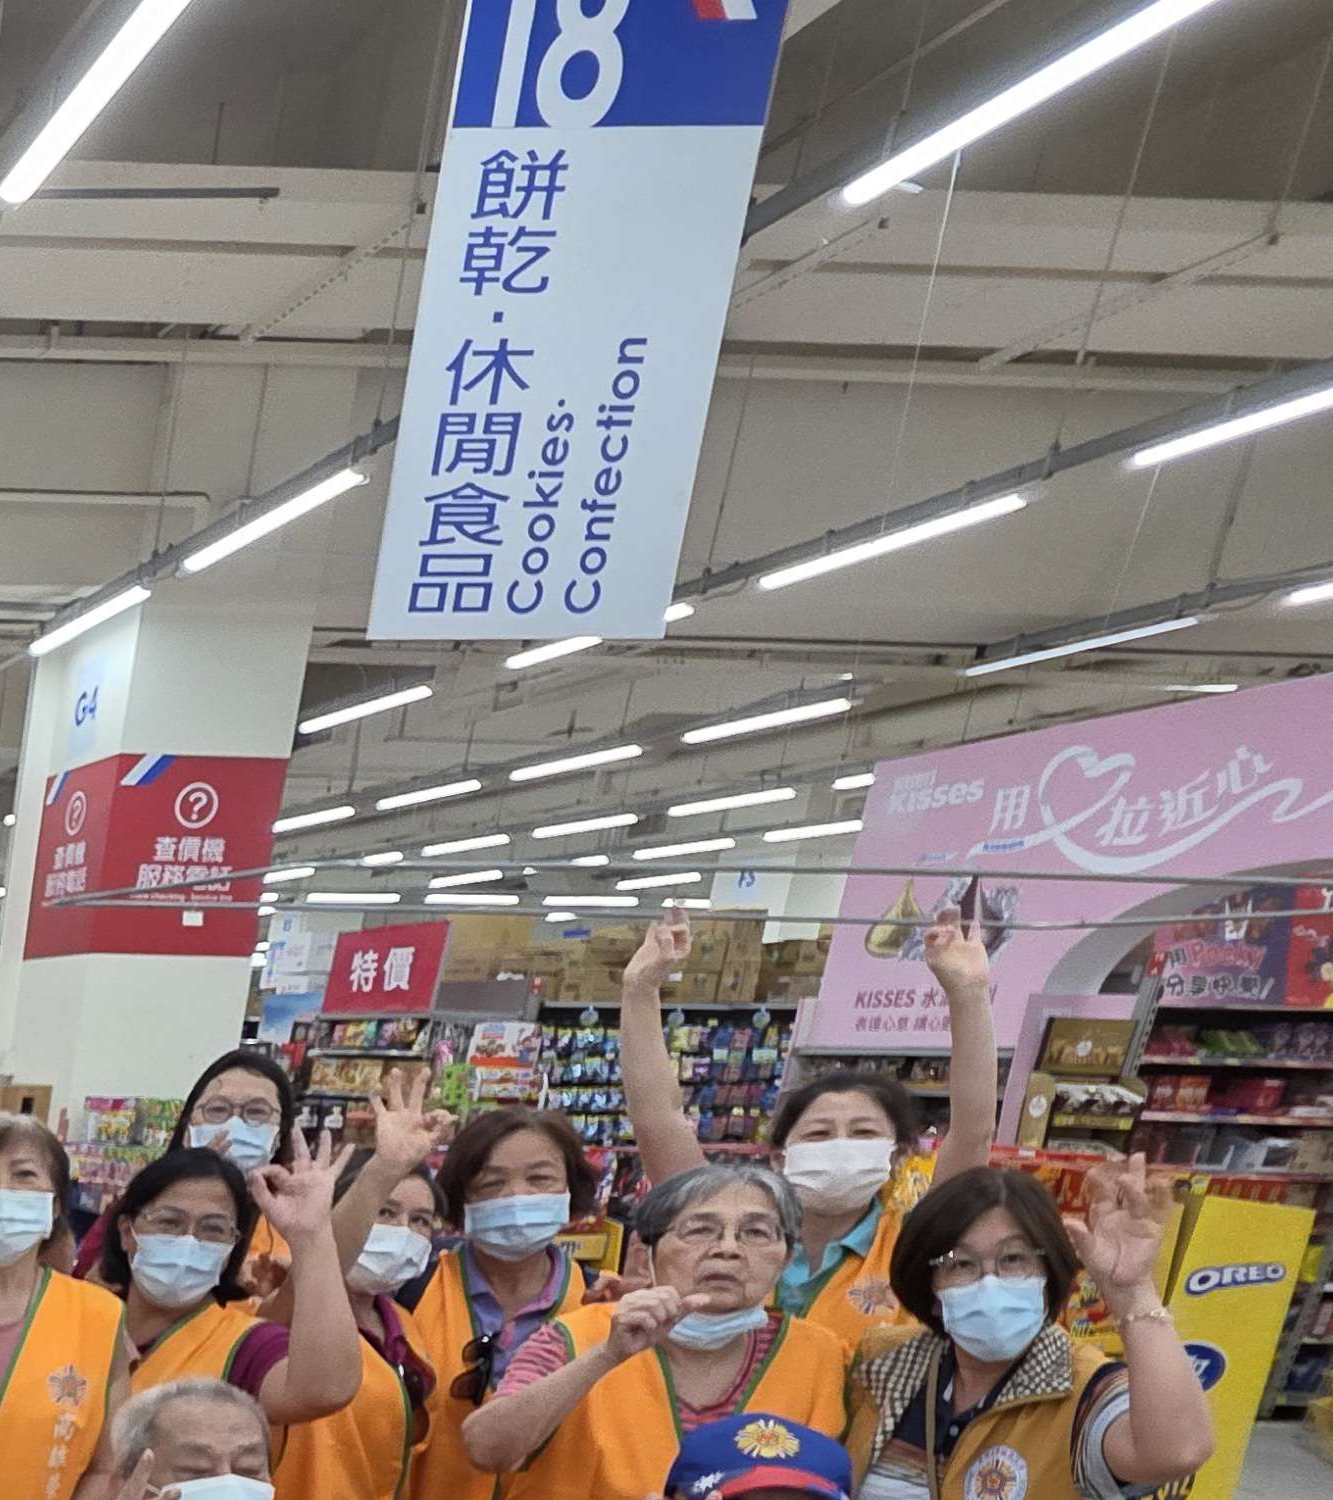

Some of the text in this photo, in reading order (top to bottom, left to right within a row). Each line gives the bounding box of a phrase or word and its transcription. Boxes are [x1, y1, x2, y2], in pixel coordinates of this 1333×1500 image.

[490, 0, 629, 129] 18
[564, 337, 648, 616] Confection
[74, 685, 99, 727] G4
[153, 836, 227, 863] 查價機
[135, 864, 233, 892] 服務電話
[349, 946, 415, 993] 特價
[855, 988, 917, 1009] KISSES
[1187, 1264, 1286, 1293] OREO
